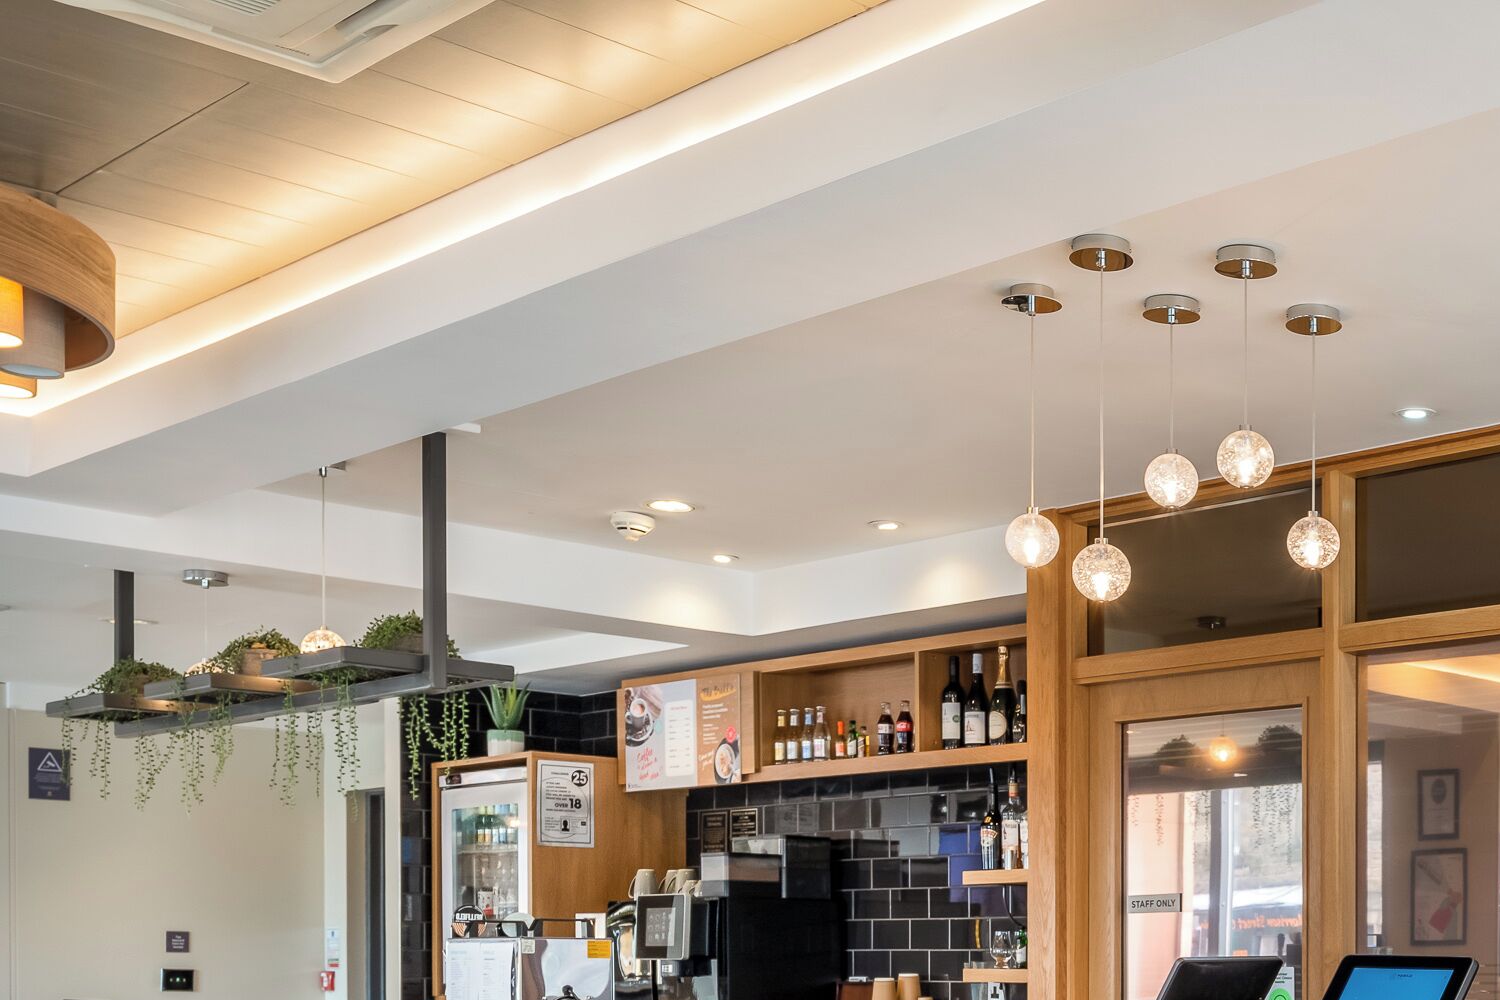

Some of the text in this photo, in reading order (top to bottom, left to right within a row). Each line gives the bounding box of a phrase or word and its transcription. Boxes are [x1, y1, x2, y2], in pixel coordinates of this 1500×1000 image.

[572, 772, 588, 784] 25
[569, 798, 582, 810] 18
[1131, 899, 1176, 909] STAFF ONLY
